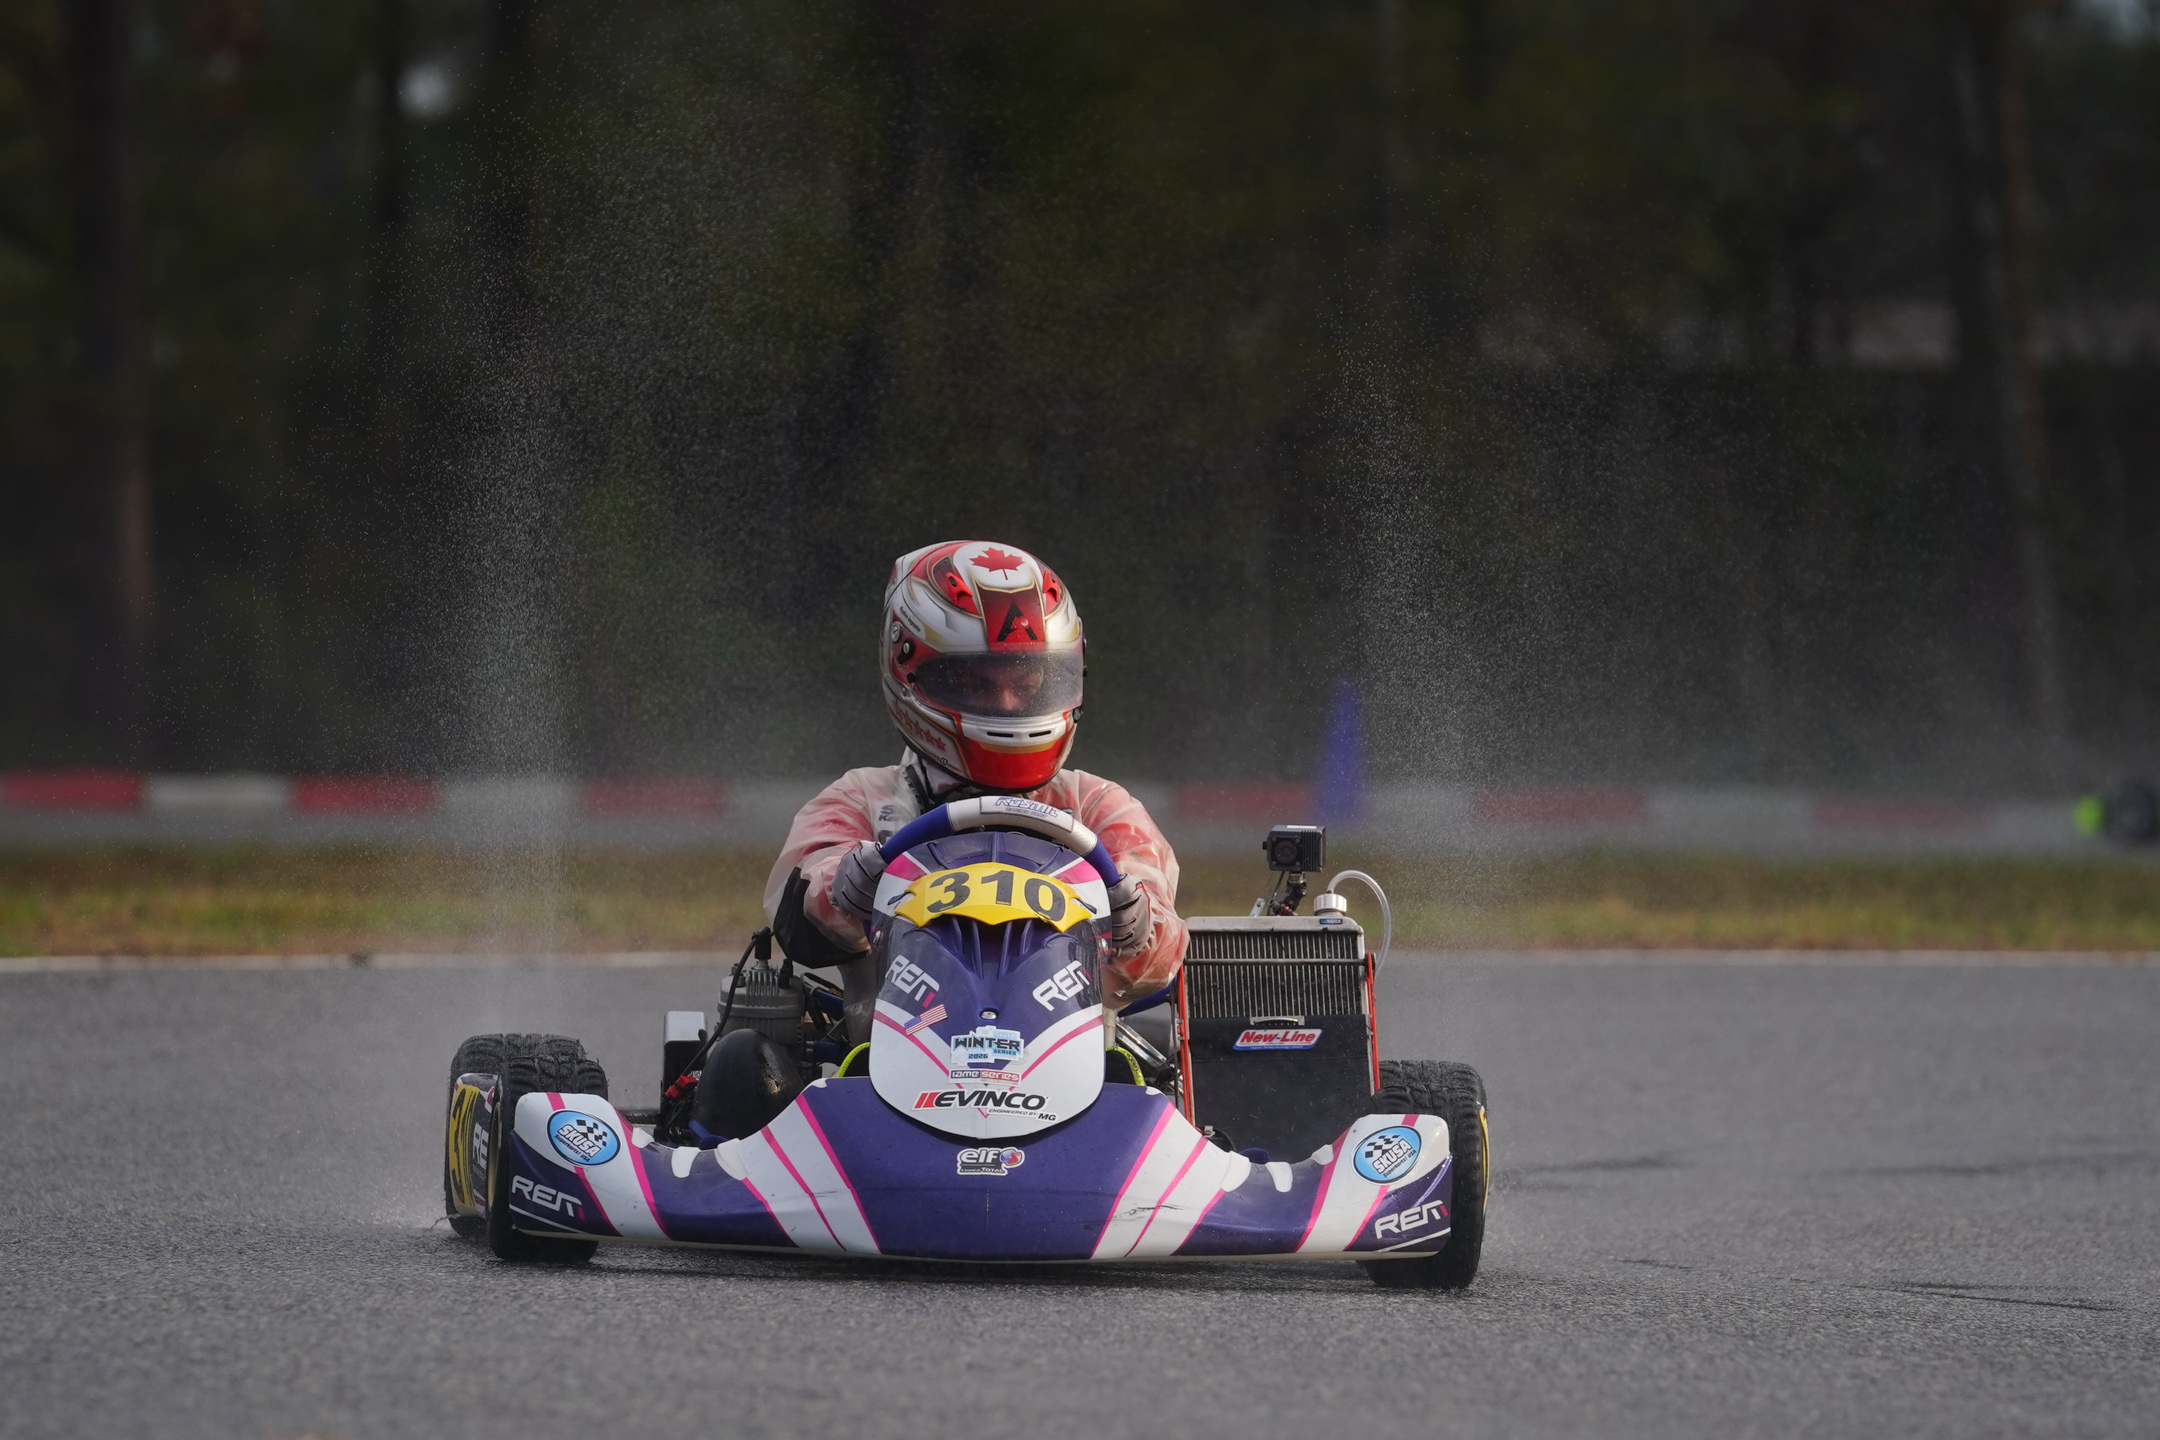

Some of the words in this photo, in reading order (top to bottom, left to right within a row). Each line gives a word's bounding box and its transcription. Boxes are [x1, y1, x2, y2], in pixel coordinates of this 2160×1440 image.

[926, 869, 1066, 922] 310
[954, 1037, 1020, 1052] WINTER
[1240, 1031, 1316, 1043] New-Line
[981, 1070, 1019, 1081] series
[934, 1090, 1046, 1110] EVINCO
[988, 1108, 1028, 1116] ENGINEERED
[1038, 1112, 1056, 1121] MG
[557, 1123, 602, 1158] SKUSA
[960, 1150, 999, 1163] elf
[1372, 1138, 1413, 1174] SKUSA
